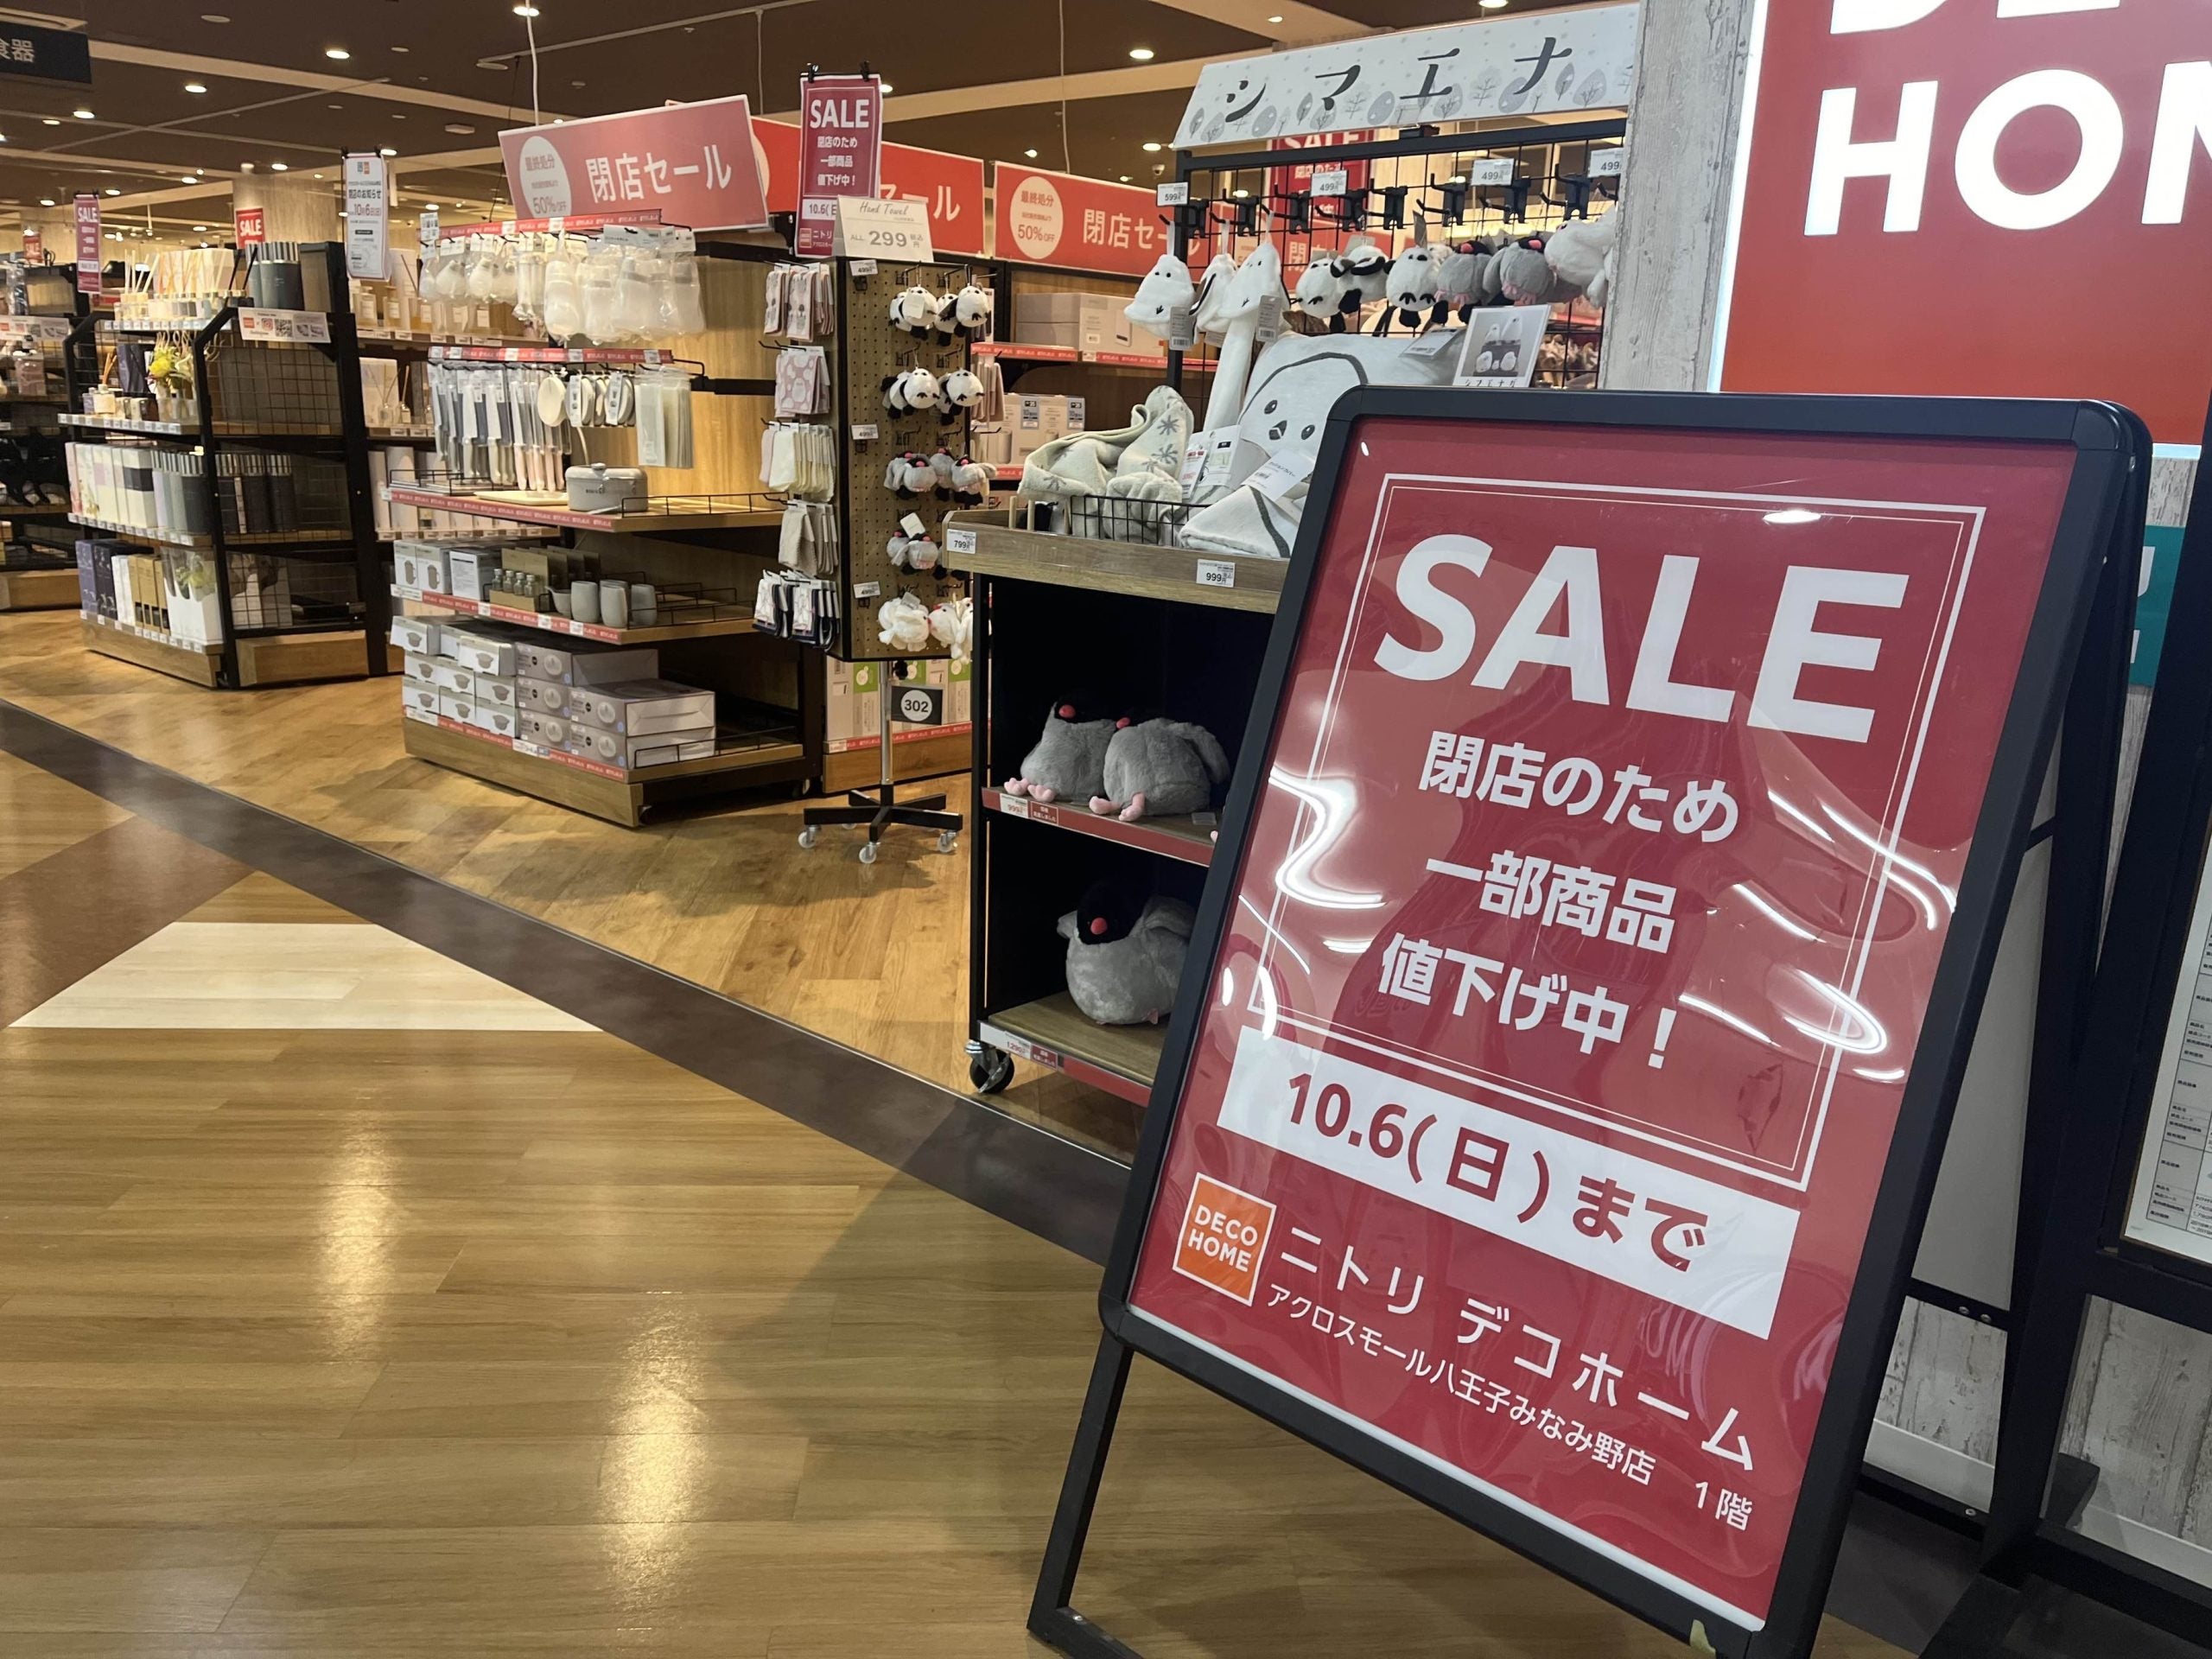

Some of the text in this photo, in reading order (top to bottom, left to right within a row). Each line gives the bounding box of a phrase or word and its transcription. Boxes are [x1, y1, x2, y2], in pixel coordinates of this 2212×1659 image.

[1225, 37, 1633, 122] シマエナ
[810, 99, 870, 129] SALE
[817, 137, 858, 149] 閉店のため
[821, 155, 854, 168] 一部商品
[1601, 161, 1620, 170] 499
[586, 144, 732, 203] 閉店セール
[1482, 171, 1498, 180] 499
[1319, 183, 1334, 192] 499
[1021, 190, 1054, 207] 最終処分
[1164, 193, 1178, 201] 599
[78, 207, 99, 223] SALE
[860, 200, 909, 216] Hand Towel
[239, 219, 263, 237] SALE
[868, 230, 907, 247] 299
[954, 540, 967, 549] 799
[1205, 572, 1222, 582] 999
[1374, 533, 1910, 744] SALE
[904, 699, 929, 713] 302
[1418, 730, 1739, 842] 閉店のため
[1426, 849, 1677, 953] 一部商品
[1378, 931, 1677, 1070] 値下げ中！
[1194, 1204, 1258, 1246] DECO
[1187, 1229, 1252, 1273] HOME
[1281, 1227, 1753, 1471] ニトリ デコホーム
[1268, 1283, 1753, 1531] アクロスモール八王子みなみ野店 1階
